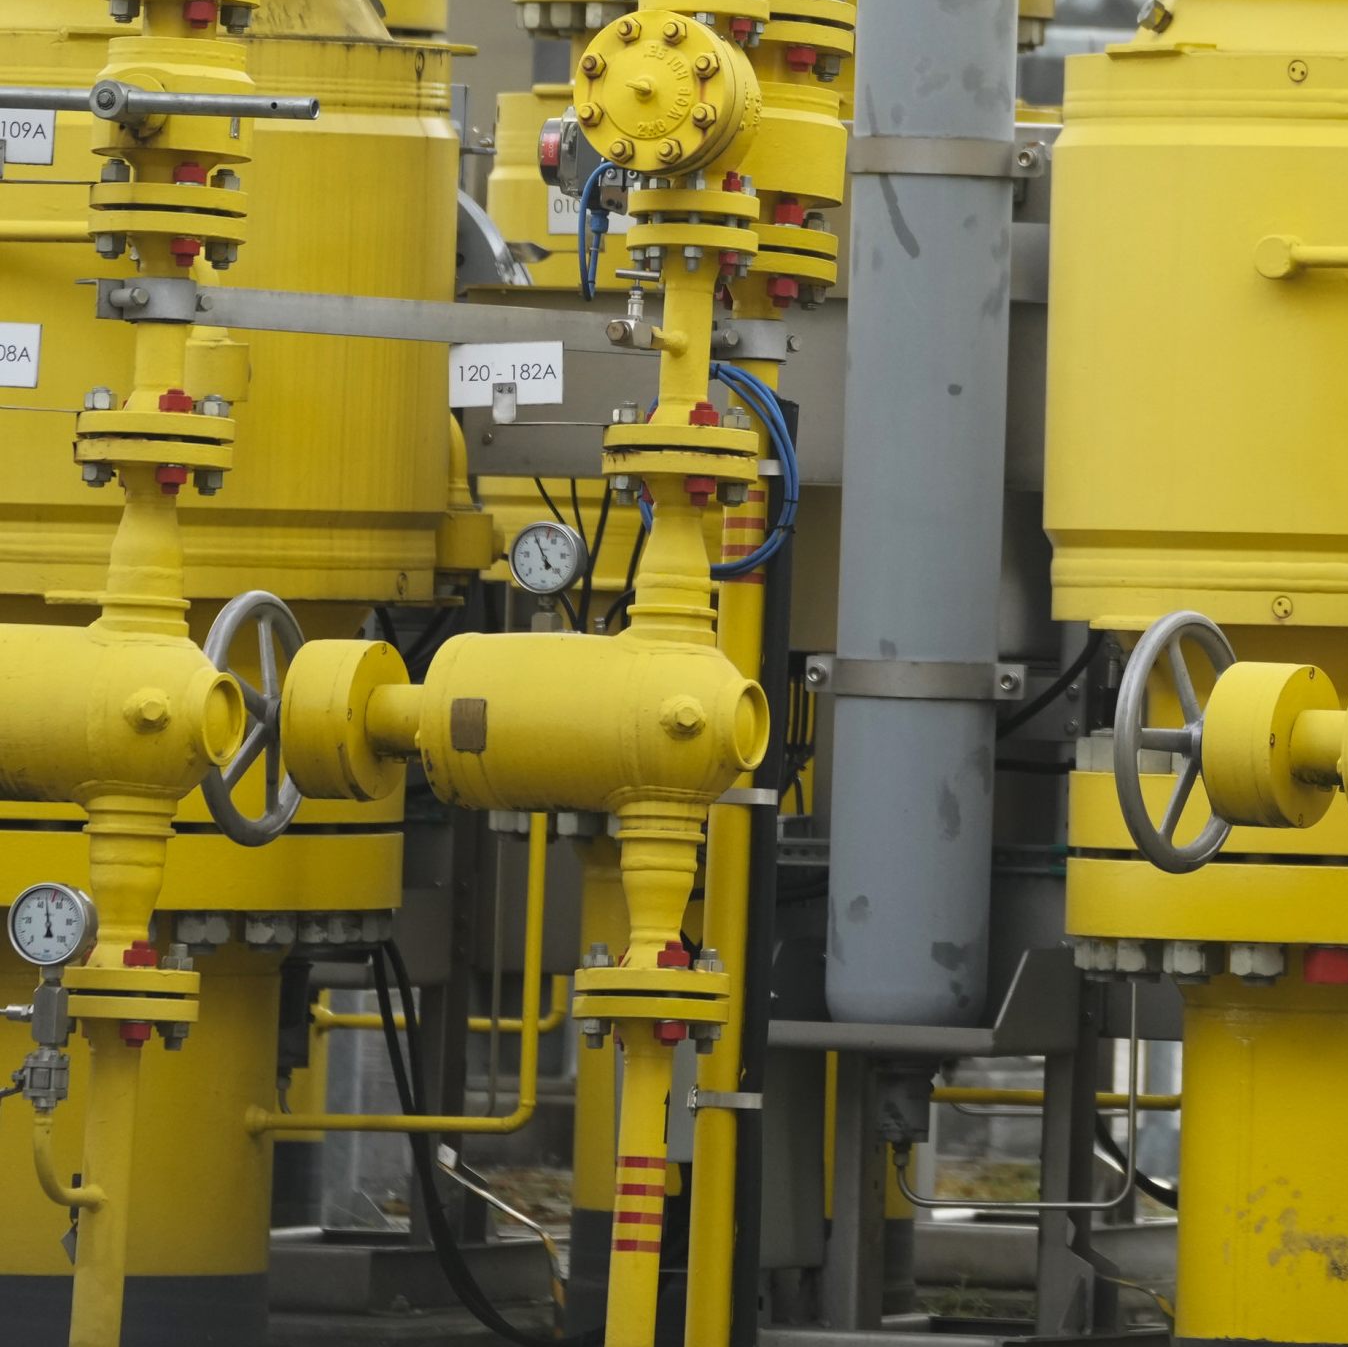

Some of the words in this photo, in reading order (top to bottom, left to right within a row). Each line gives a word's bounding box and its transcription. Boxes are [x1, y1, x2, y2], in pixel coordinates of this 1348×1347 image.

[2, 120, 47, 140] 109A
[459, 364, 490, 382] 120
[511, 363, 557, 381] 182A
